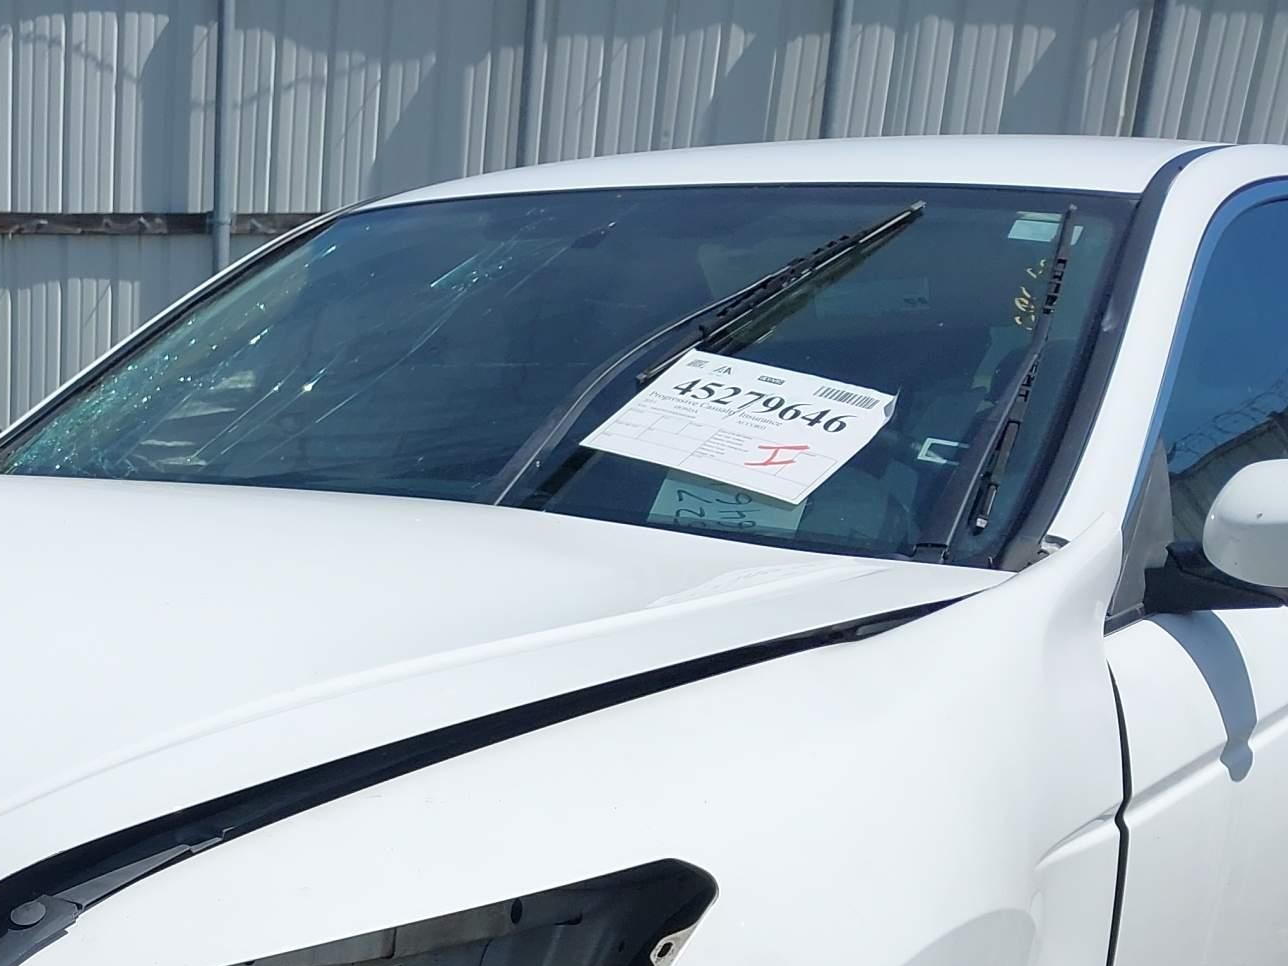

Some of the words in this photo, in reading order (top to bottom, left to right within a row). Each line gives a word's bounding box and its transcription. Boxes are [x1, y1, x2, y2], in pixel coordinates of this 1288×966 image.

[648, 391, 699, 407] Progressive
[738, 411, 783, 428] Insurance
[674, 378, 857, 433] 45279646
